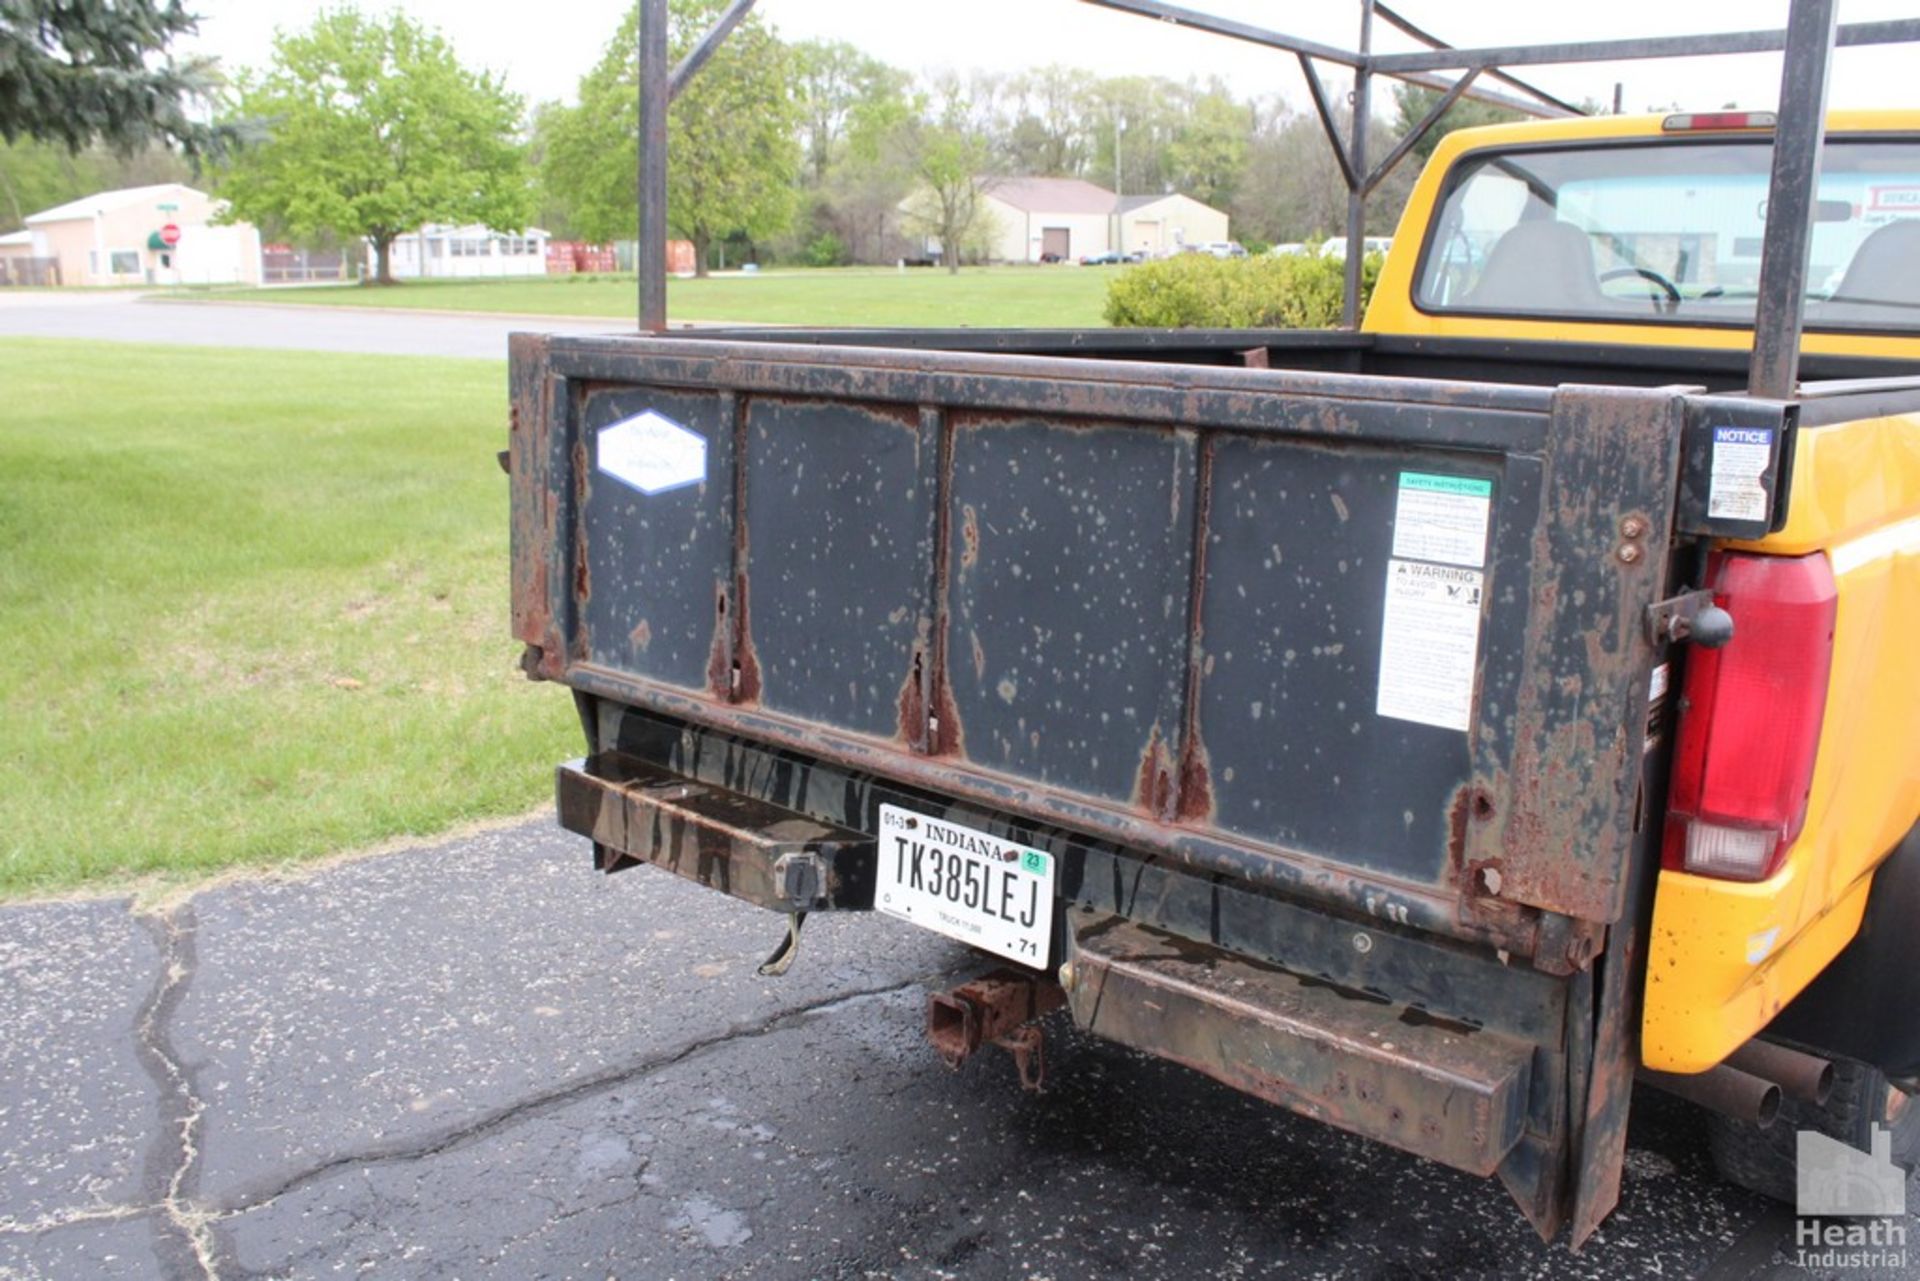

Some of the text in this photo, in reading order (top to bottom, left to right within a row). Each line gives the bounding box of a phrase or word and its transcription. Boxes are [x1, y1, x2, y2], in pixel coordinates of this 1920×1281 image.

[1717, 429, 1768, 443] NOTICE
[1405, 478, 1432, 487] SAFETY
[1410, 564, 1475, 582] WARNING
[883, 811, 908, 830] 01-3
[925, 822, 1004, 862] INDIANA
[1026, 852, 1040, 868] 23
[894, 836, 1038, 929] TK385LEJ
[1019, 938, 1038, 957] 71
